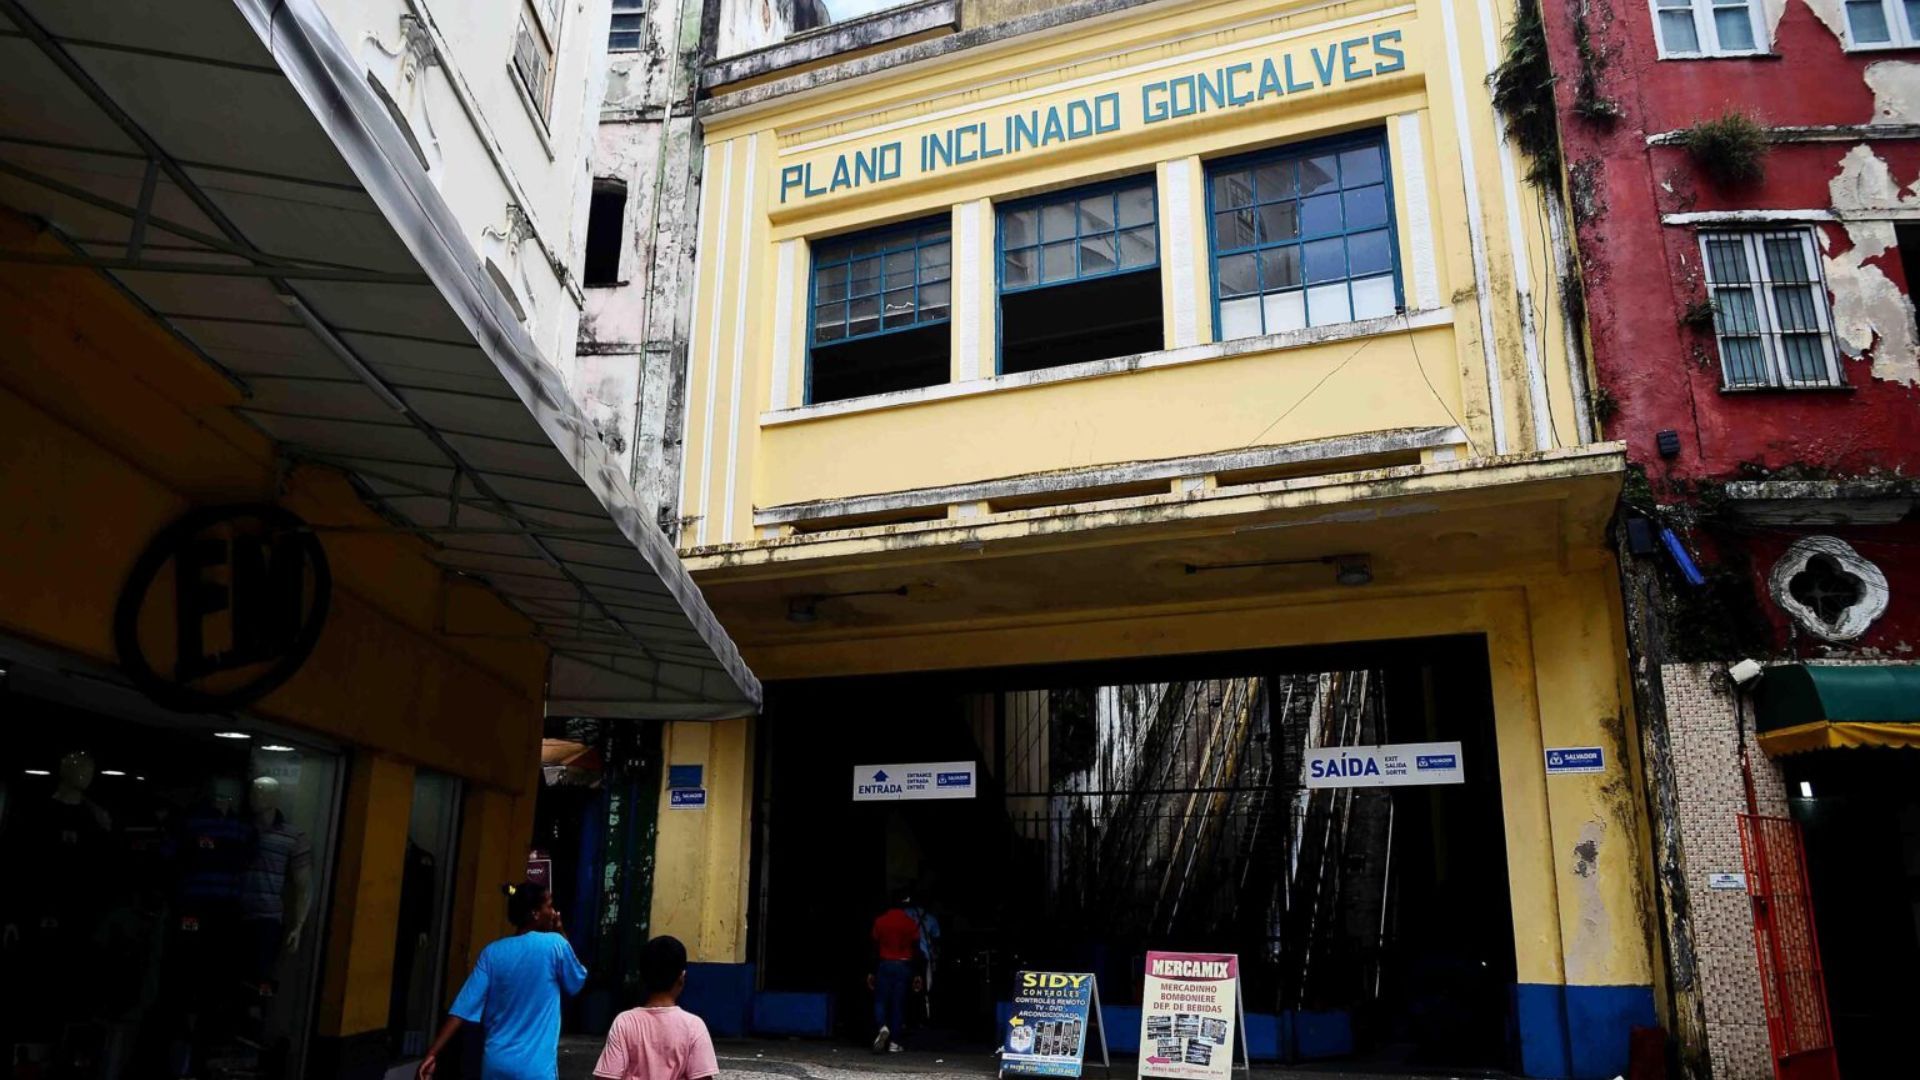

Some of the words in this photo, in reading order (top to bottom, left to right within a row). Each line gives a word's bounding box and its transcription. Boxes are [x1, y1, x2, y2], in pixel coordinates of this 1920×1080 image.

[780, 142, 902, 203] PLANO
[920, 92, 1121, 172] INCLINADO
[1141, 29, 1406, 125] GONÇALVES
[1310, 752, 1381, 779] SAÍDA
[858, 784, 903, 795] ENTRADA
[1151, 959, 1230, 979] MERCAMIX
[1022, 973, 1088, 989] SIDY
[1023, 988, 1080, 998] CONTROLES
[1160, 983, 1218, 993] MERCADINHO
[1015, 997, 1056, 1005] CONTROLES
[1057, 998, 1086, 1006] REMOTO
[1160, 993, 1216, 1003] BOMBONIERE
[1153, 1002, 1171, 1010] DEP.
[1173, 1003, 1185, 1011] DE
[1187, 1004, 1222, 1013] BEBIDAS
